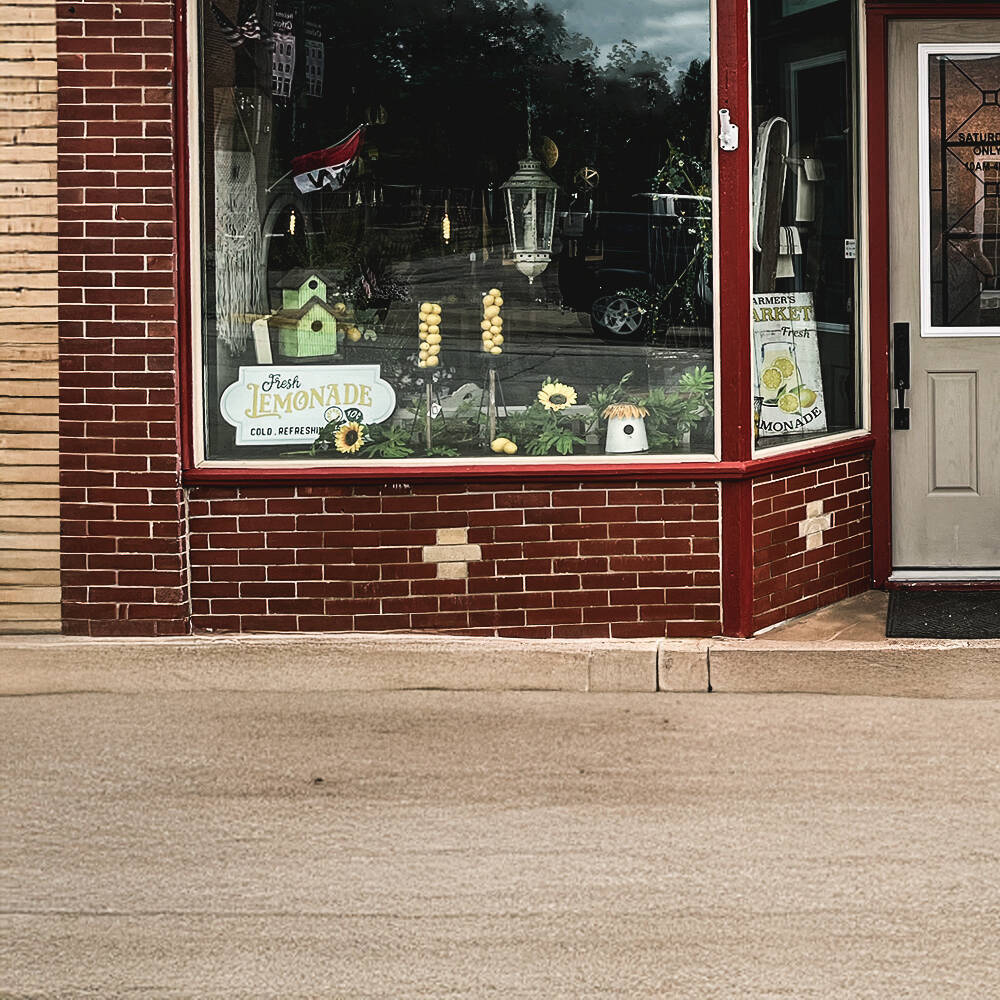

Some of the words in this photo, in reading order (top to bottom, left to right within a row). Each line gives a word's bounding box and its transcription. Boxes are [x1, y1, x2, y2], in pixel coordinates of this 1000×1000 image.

[781, 326, 810, 338] Fresh
[262, 373, 301, 392] Fresh
[245, 383, 373, 419] LEMONADE
